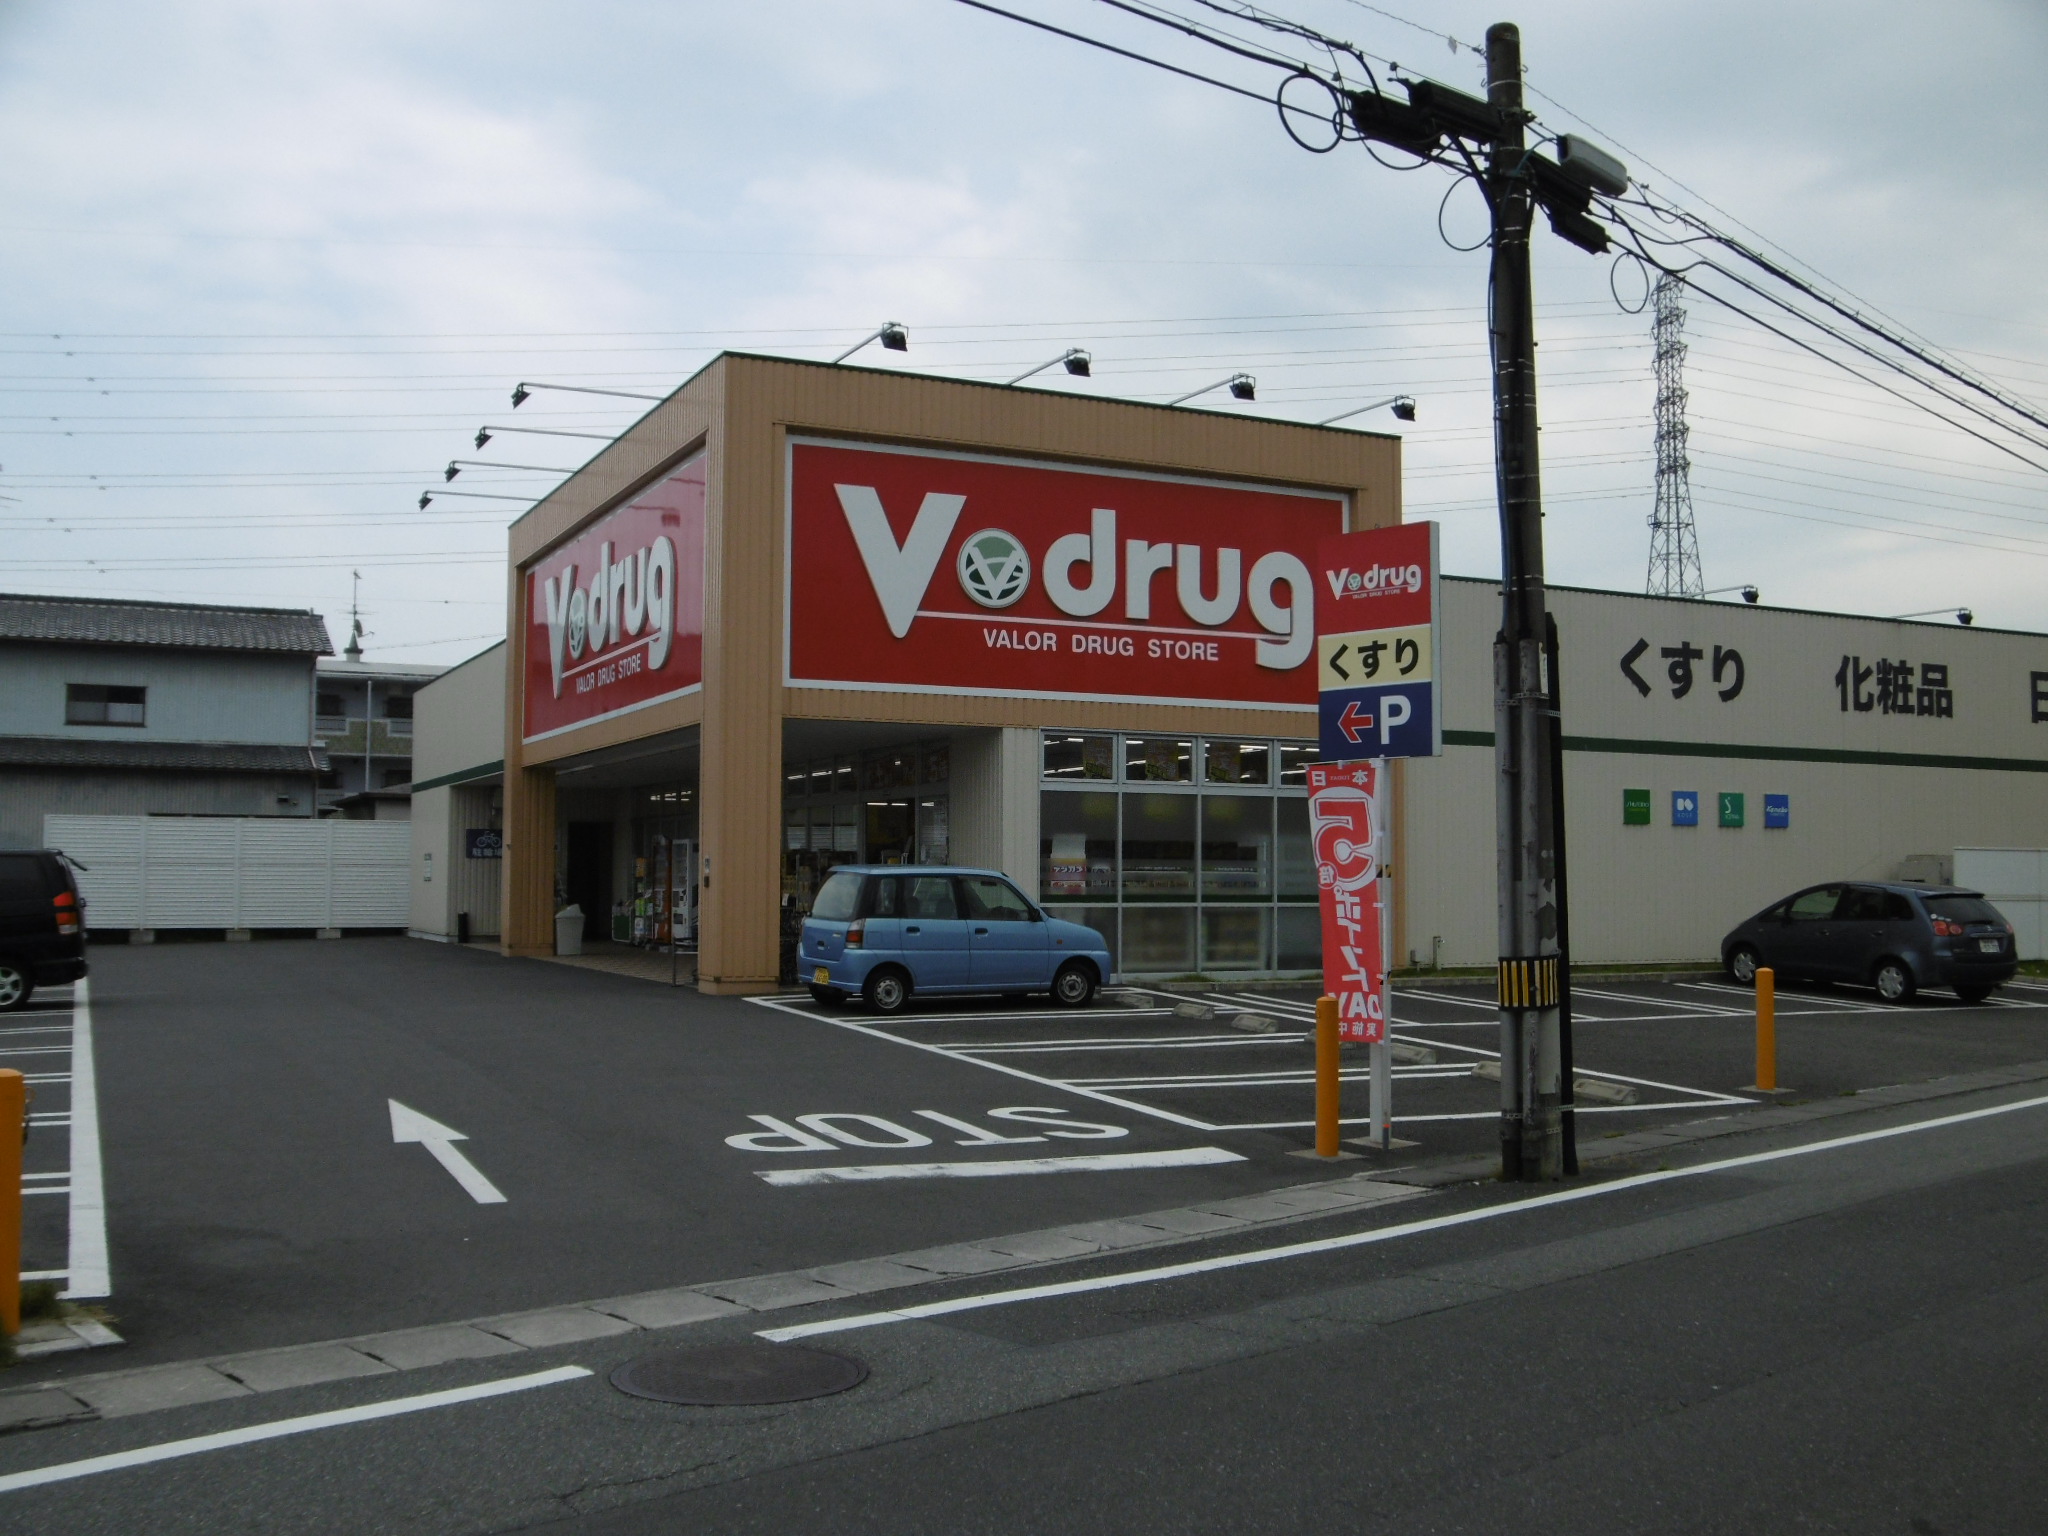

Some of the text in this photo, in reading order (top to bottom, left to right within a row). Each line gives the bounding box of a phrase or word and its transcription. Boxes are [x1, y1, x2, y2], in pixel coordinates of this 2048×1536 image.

[1385, 588, 1401, 596] STORE
[983, 628, 1219, 661] VALOR DRUG STORE
[1329, 638, 1419, 681] くすり
[576, 653, 641, 694] VALOR DRUG STORE
[1620, 637, 1744, 702] くすり
[1835, 654, 1953, 718] 化粧品
[1380, 695, 1412, 745] P
[725, 1106, 1129, 1151] STOP
